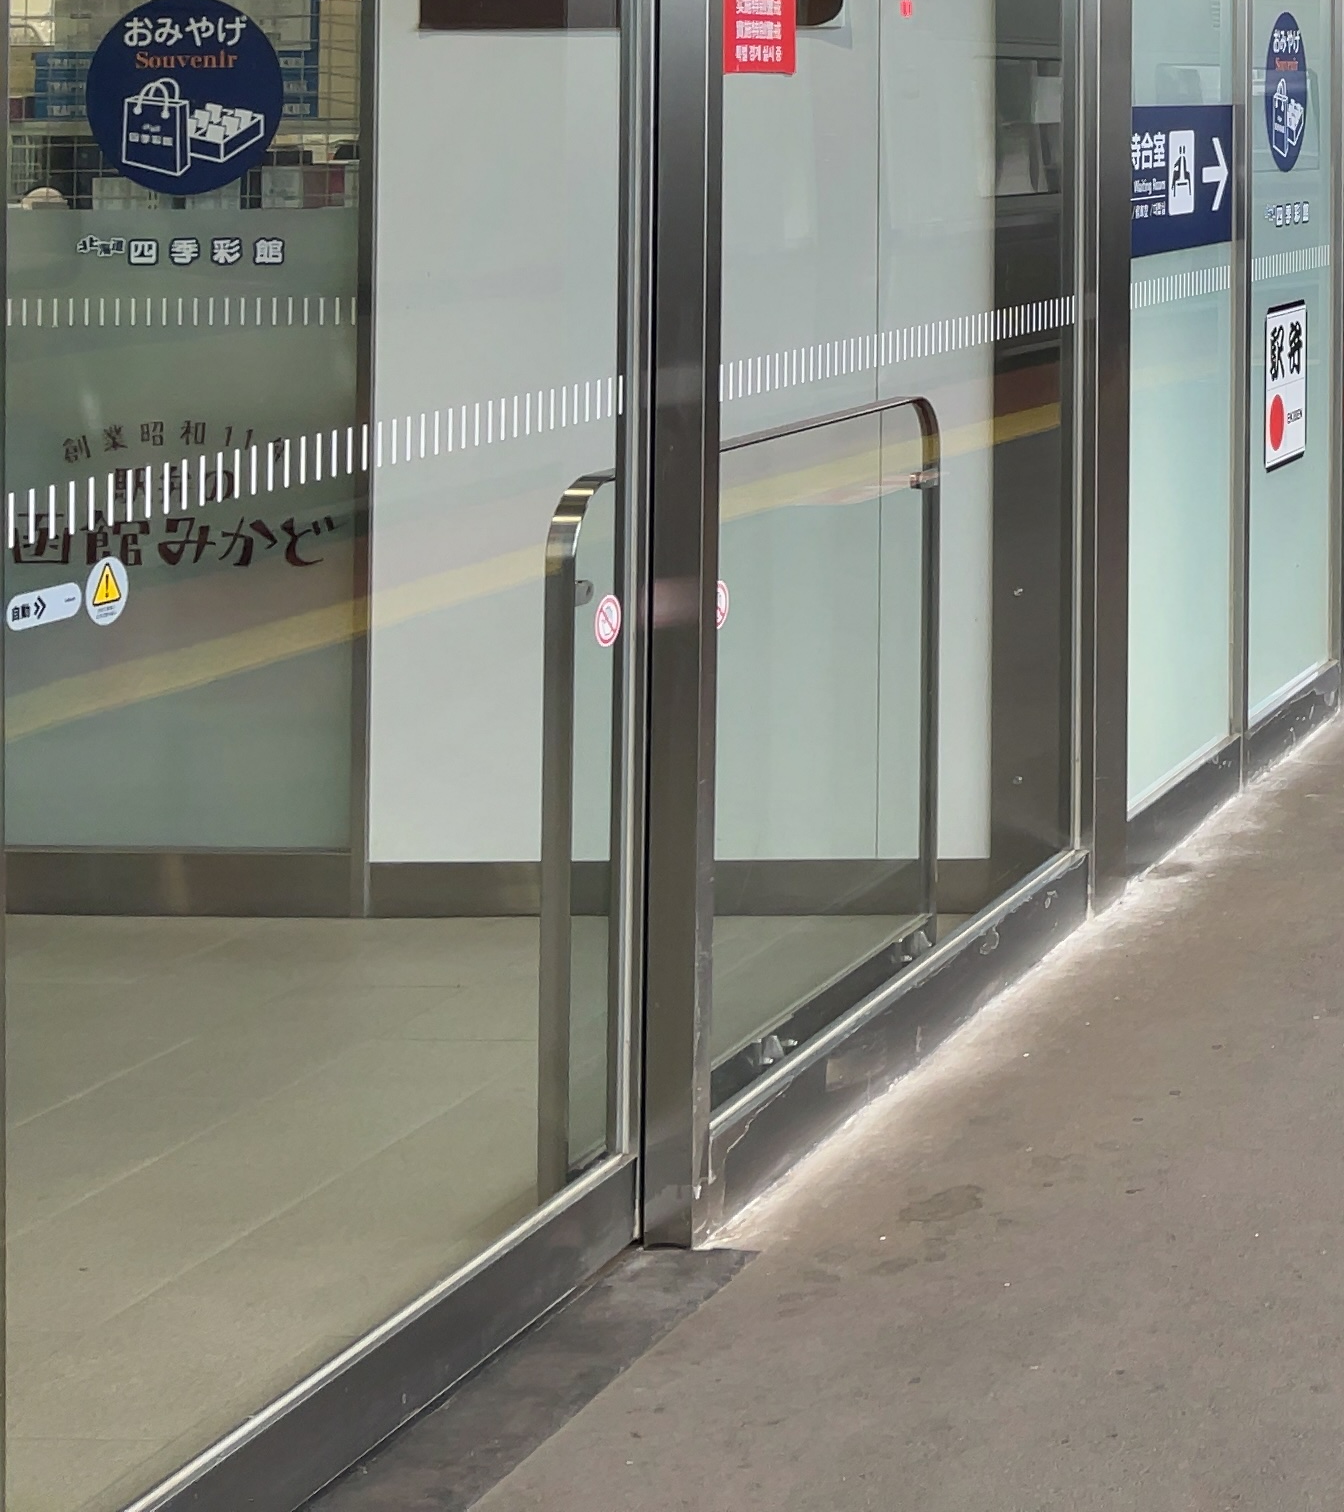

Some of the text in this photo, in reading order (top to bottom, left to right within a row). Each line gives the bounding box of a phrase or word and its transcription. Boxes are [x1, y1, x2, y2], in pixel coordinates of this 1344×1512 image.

[124, 16, 248, 47] おみやげ
[1273, 29, 1300, 54] おみやげ
[135, 50, 238, 70] Souvenir
[1131, 131, 1166, 170] 待合室
[1270, 320, 1303, 381] 駅弁
